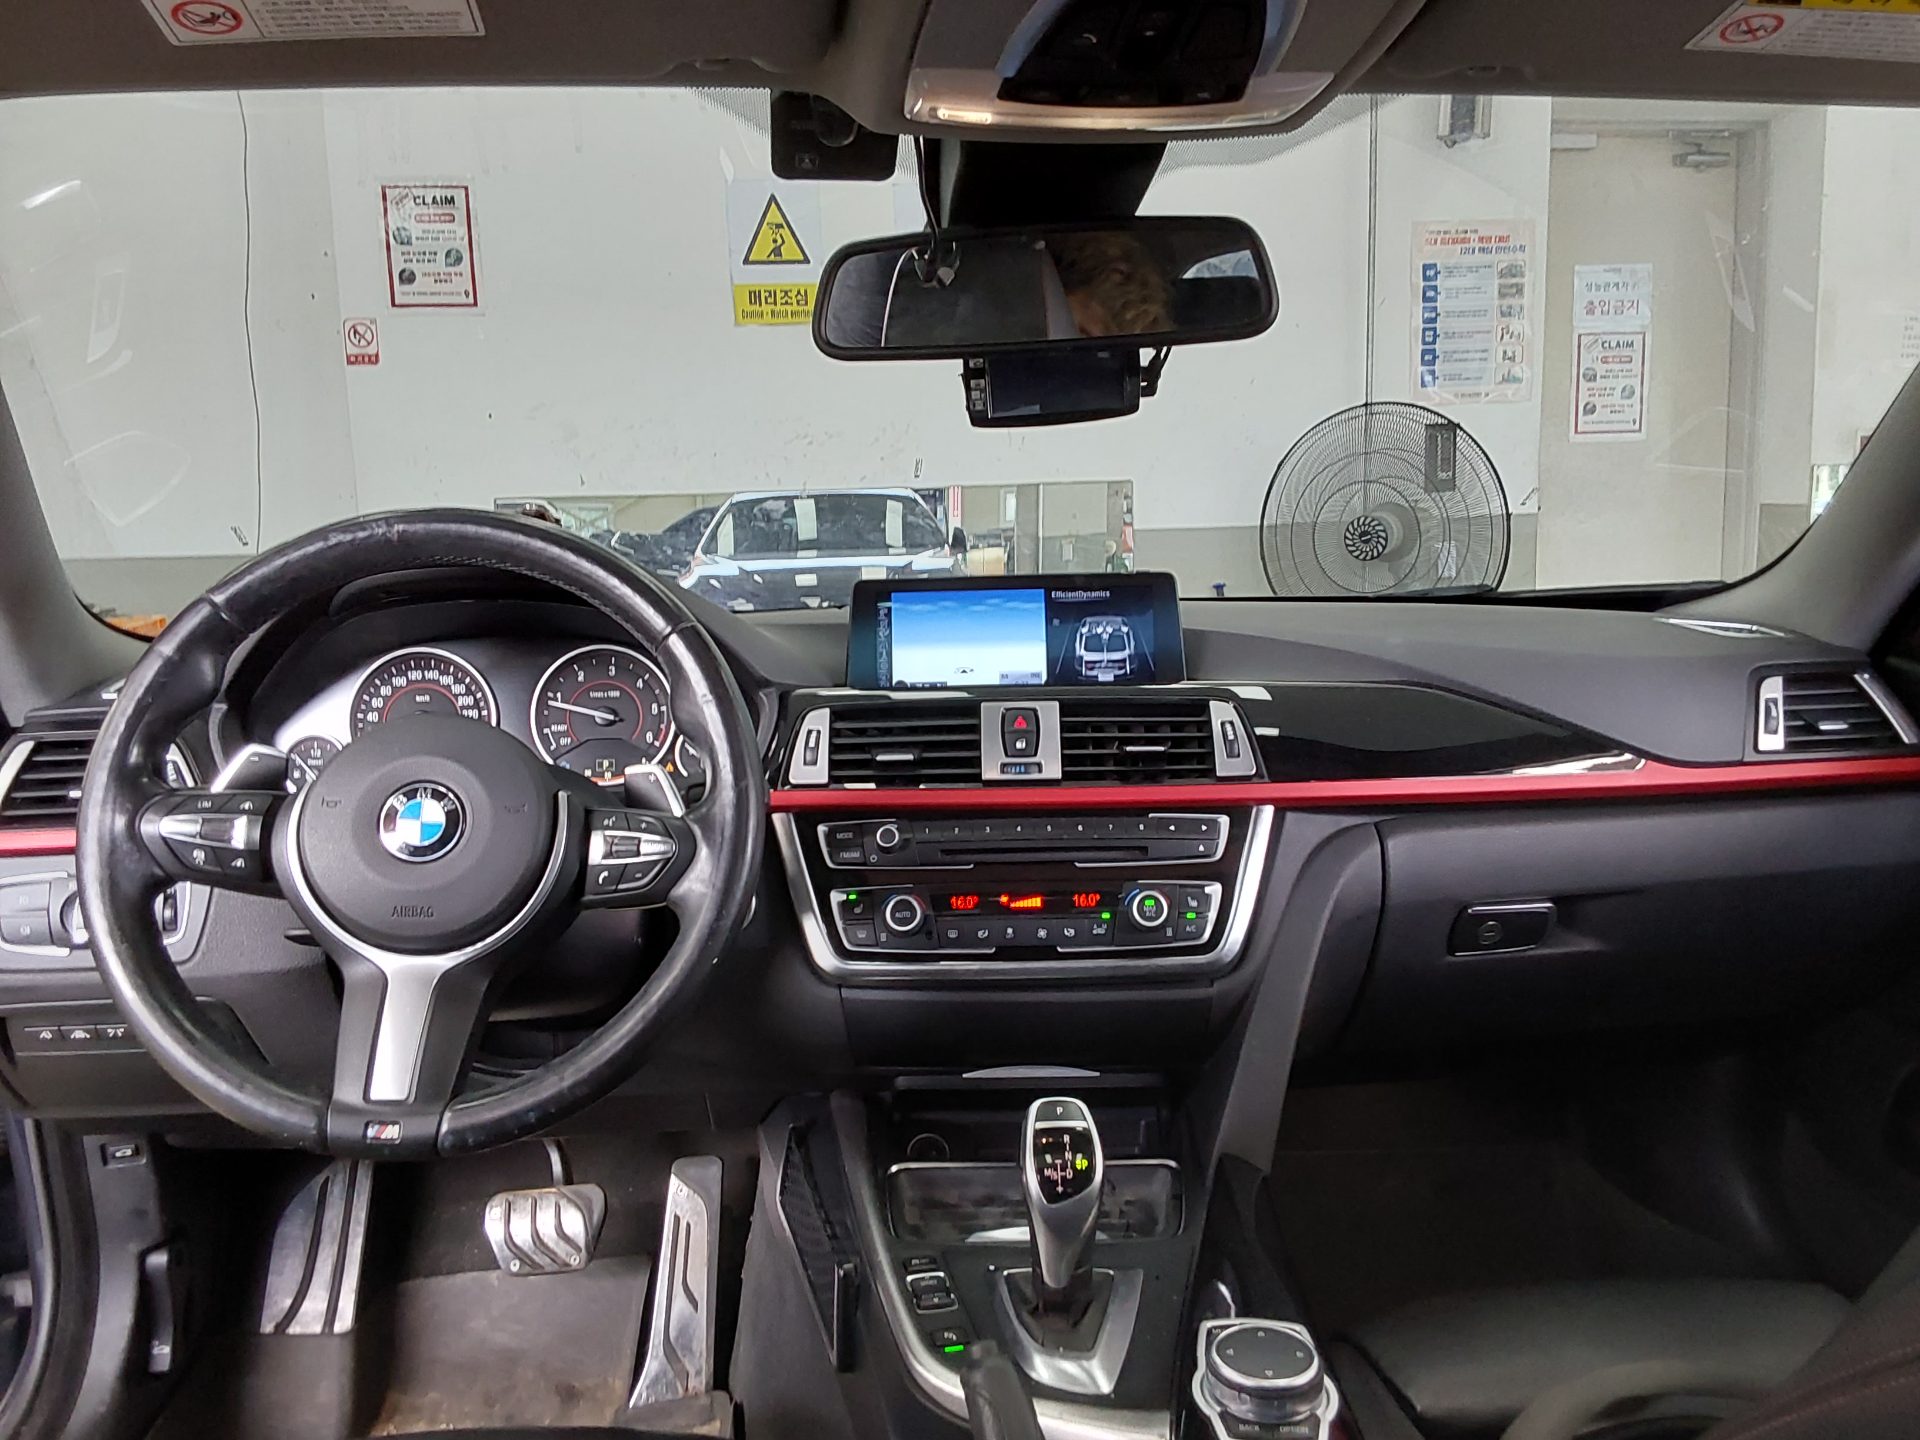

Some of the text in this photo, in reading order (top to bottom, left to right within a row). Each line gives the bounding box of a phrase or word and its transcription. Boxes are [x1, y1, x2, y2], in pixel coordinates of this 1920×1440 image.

[413, 195, 456, 206] CLAIM
[748, 289, 809, 307] 머리조심
[1584, 299, 1640, 316] 출입금지
[741, 308, 764, 320] Caution
[770, 308, 789, 319] Watch
[1601, 339, 1635, 350] CLAIM
[1051, 590, 1110, 599] EfficientDynamics
[408, 670, 423, 681] 120
[424, 670, 440, 681] 140
[608, 665, 616, 676] 3
[392, 676, 407, 687] 100
[439, 675, 454, 686] 160
[636, 679, 643, 690] 4
[371, 698, 384, 709] 60
[458, 695, 474, 707] 200
[367, 711, 379, 723] 40
[560, 737, 572, 746] OFF
[985, 826, 990, 834] 3
[1108, 824, 1114, 832] 7
[391, 905, 434, 918] AIRBAG
[1185, 924, 1197, 933] A/C
[1056, 1106, 1064, 1115] P
[1063, 1134, 1070, 1144] R
[1065, 1151, 1072, 1160] N
[1066, 1168, 1073, 1179] D
[1239, 1423, 1260, 1431] BACK
